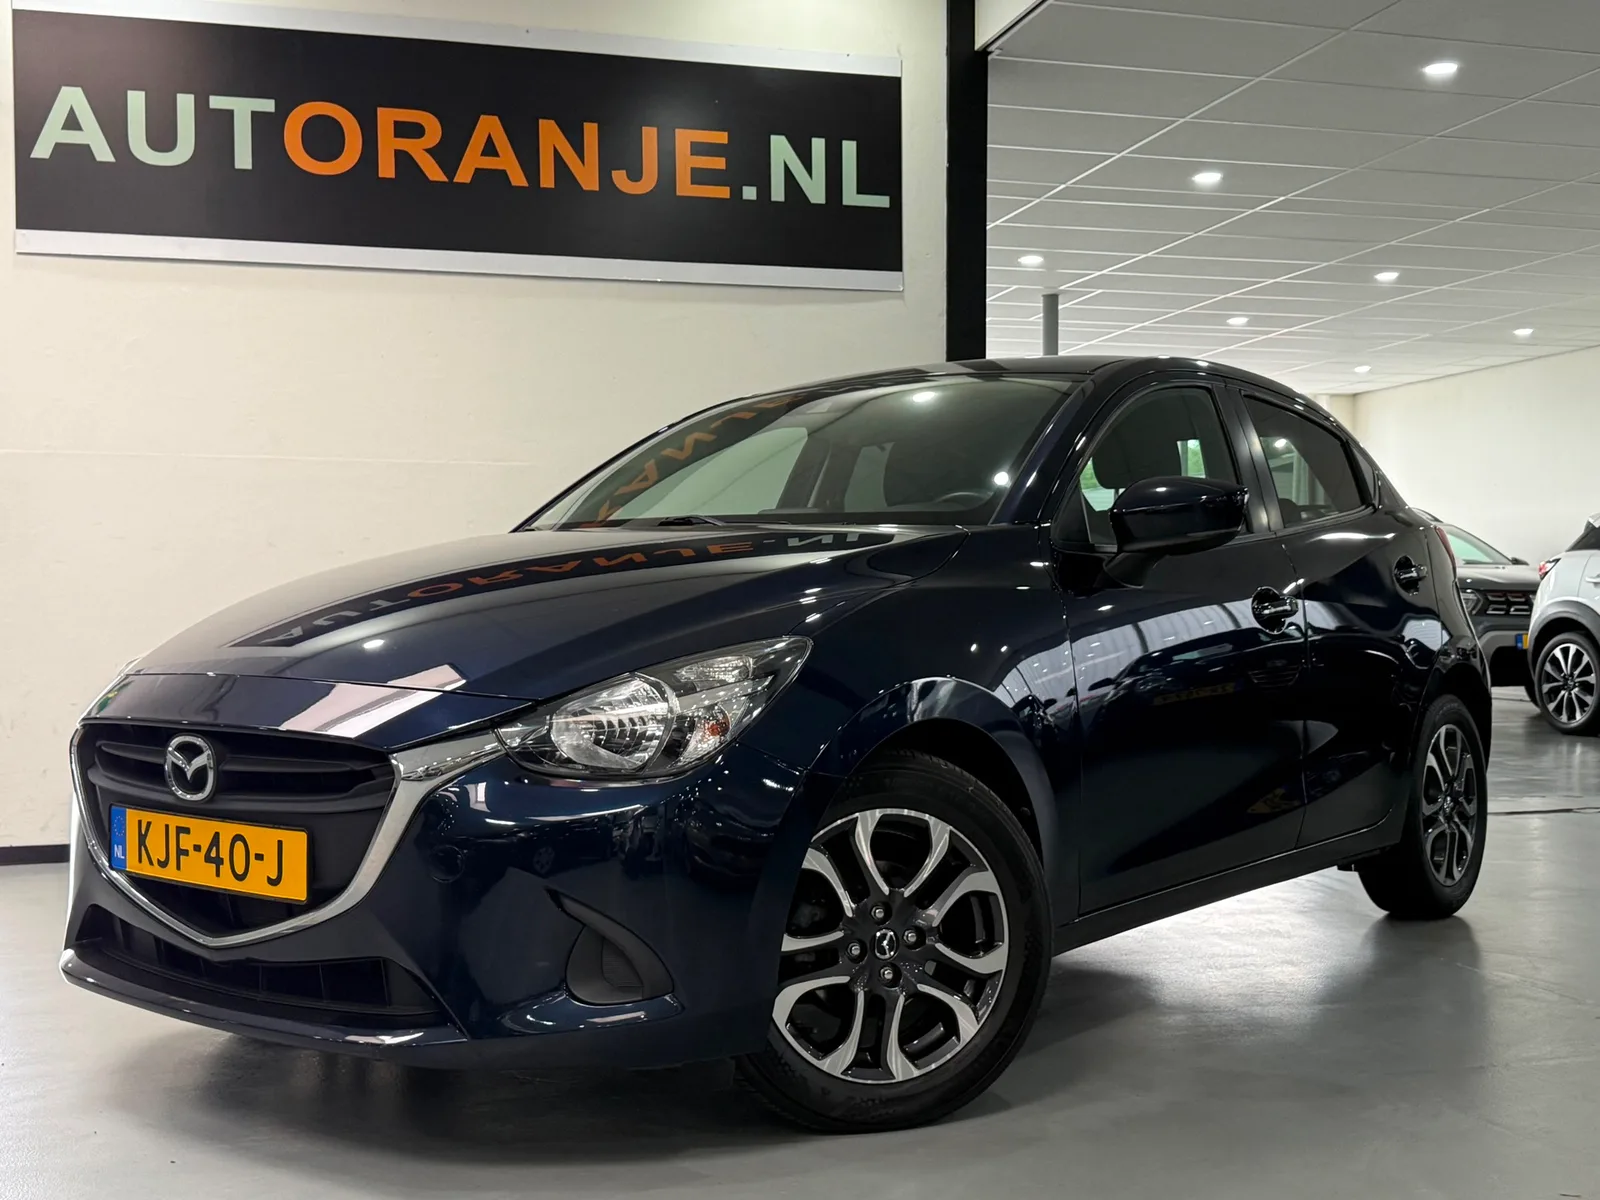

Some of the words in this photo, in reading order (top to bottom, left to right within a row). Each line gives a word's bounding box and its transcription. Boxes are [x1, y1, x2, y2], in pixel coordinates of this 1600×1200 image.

[30, 85, 890, 208] AUTORANJE.NL
[114, 844, 125, 859] NL
[137, 819, 284, 887] KJF-40-J
